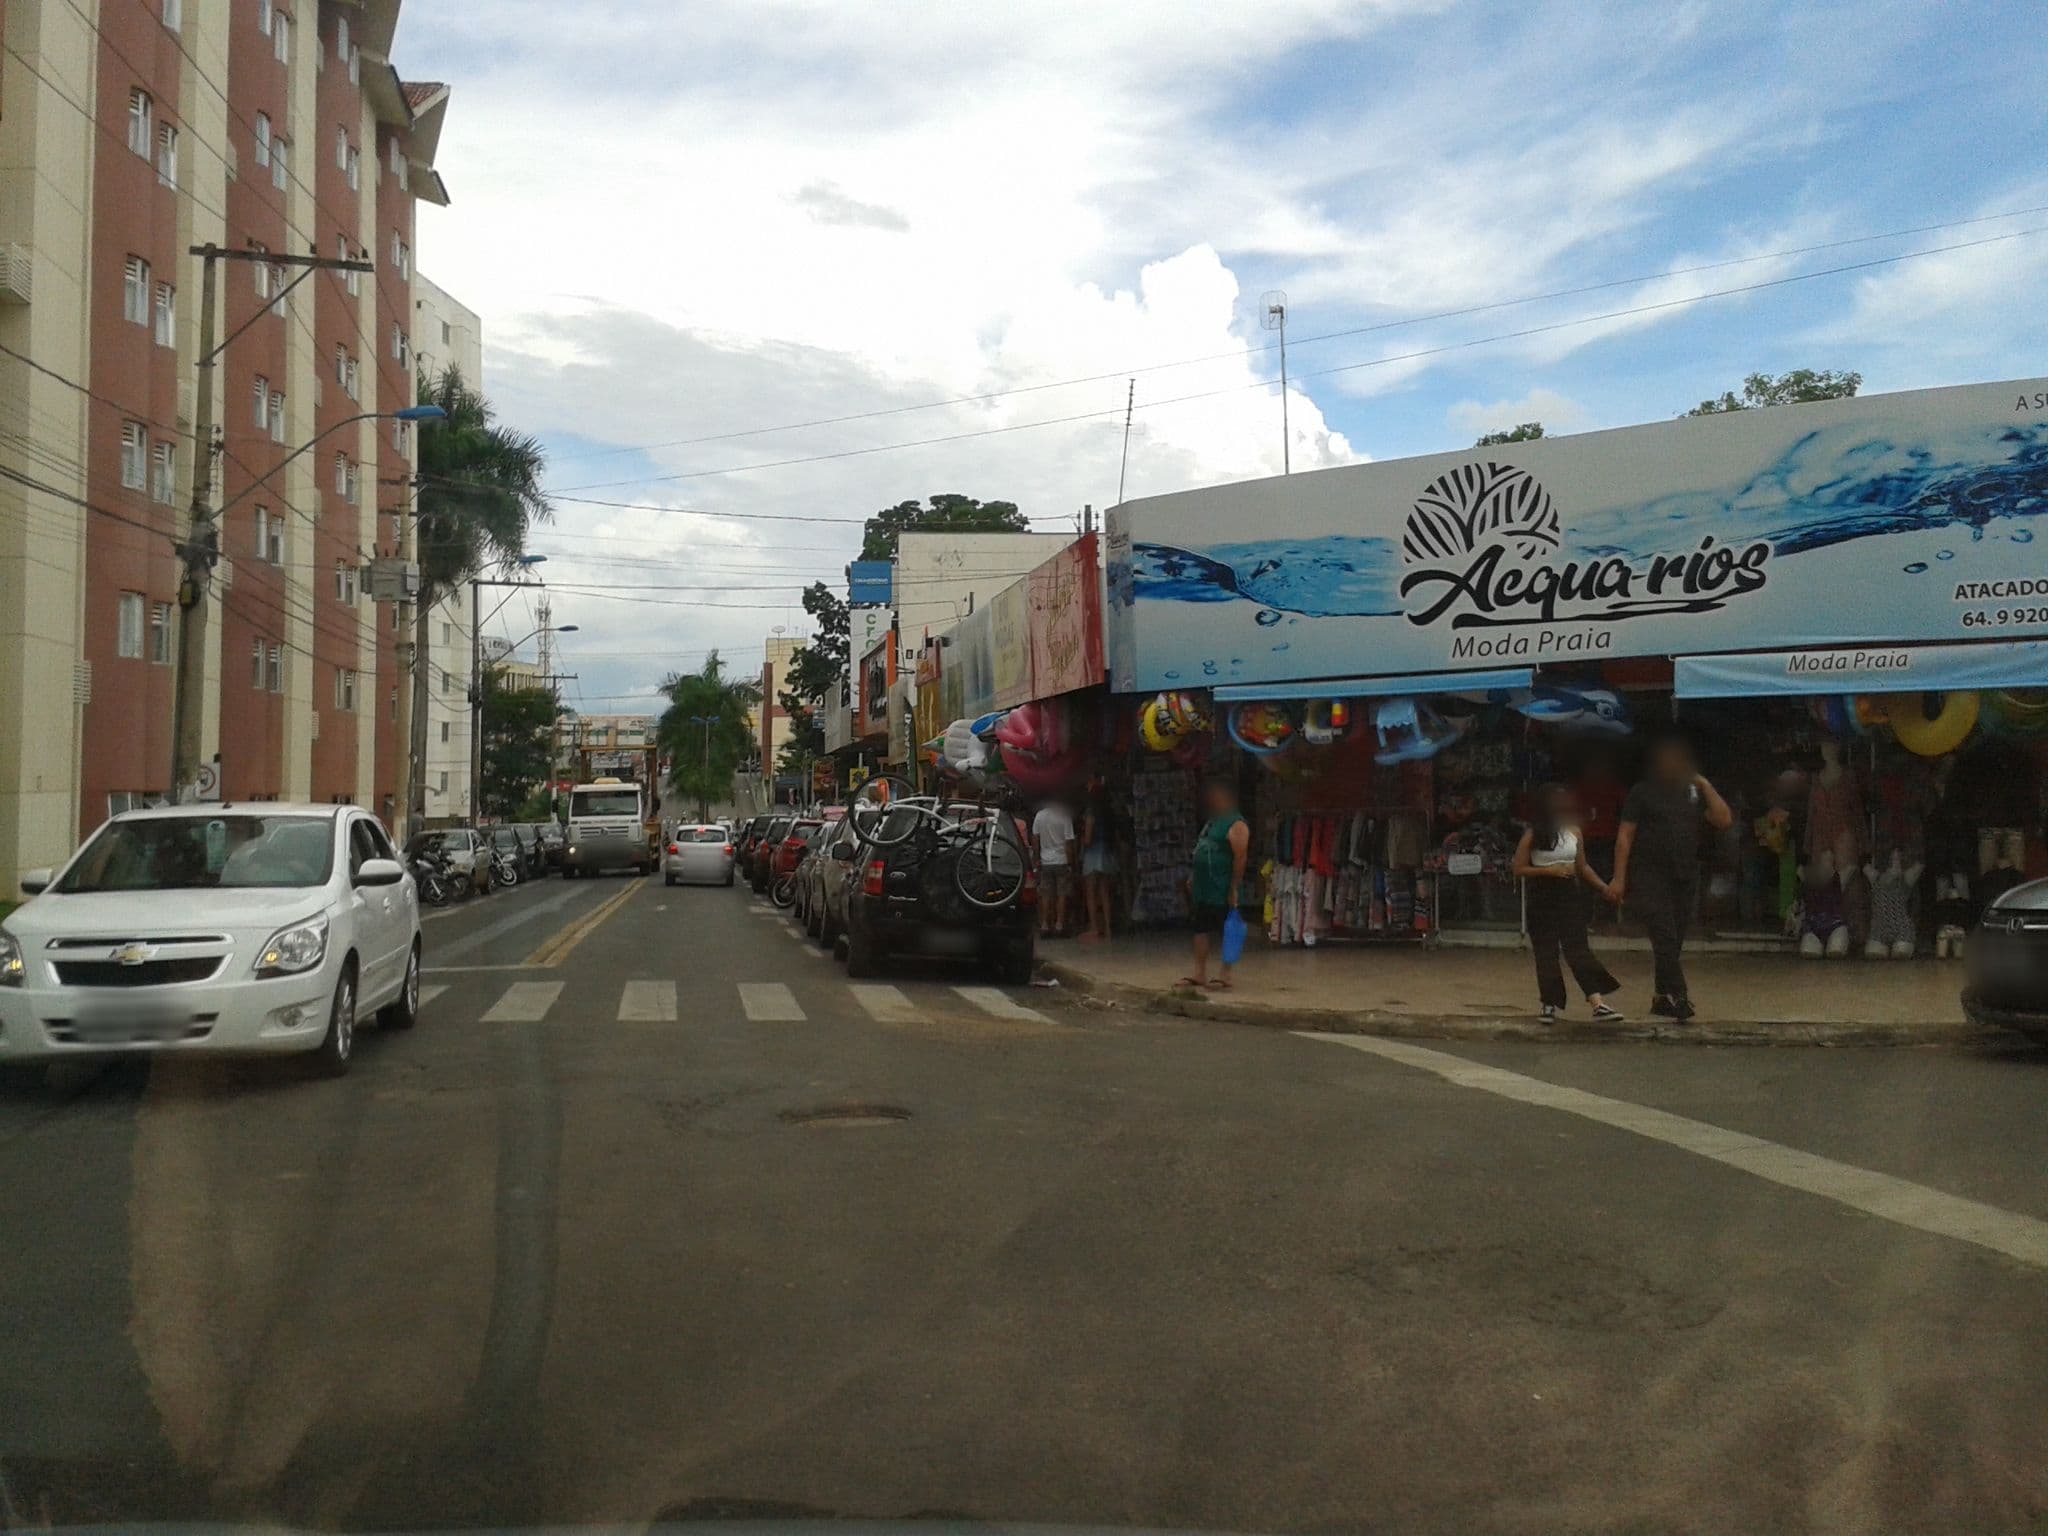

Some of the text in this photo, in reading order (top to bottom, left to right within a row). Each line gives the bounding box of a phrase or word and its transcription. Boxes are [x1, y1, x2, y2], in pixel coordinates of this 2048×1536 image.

[2015, 395, 2029, 412] A
[1955, 580, 2048, 600] ATACADO
[1962, 611, 1992, 627] 64.
[1997, 609, 2009, 625] 9
[1452, 627, 1611, 659] Moda Praia
[1788, 650, 1908, 671] Moda Praia
